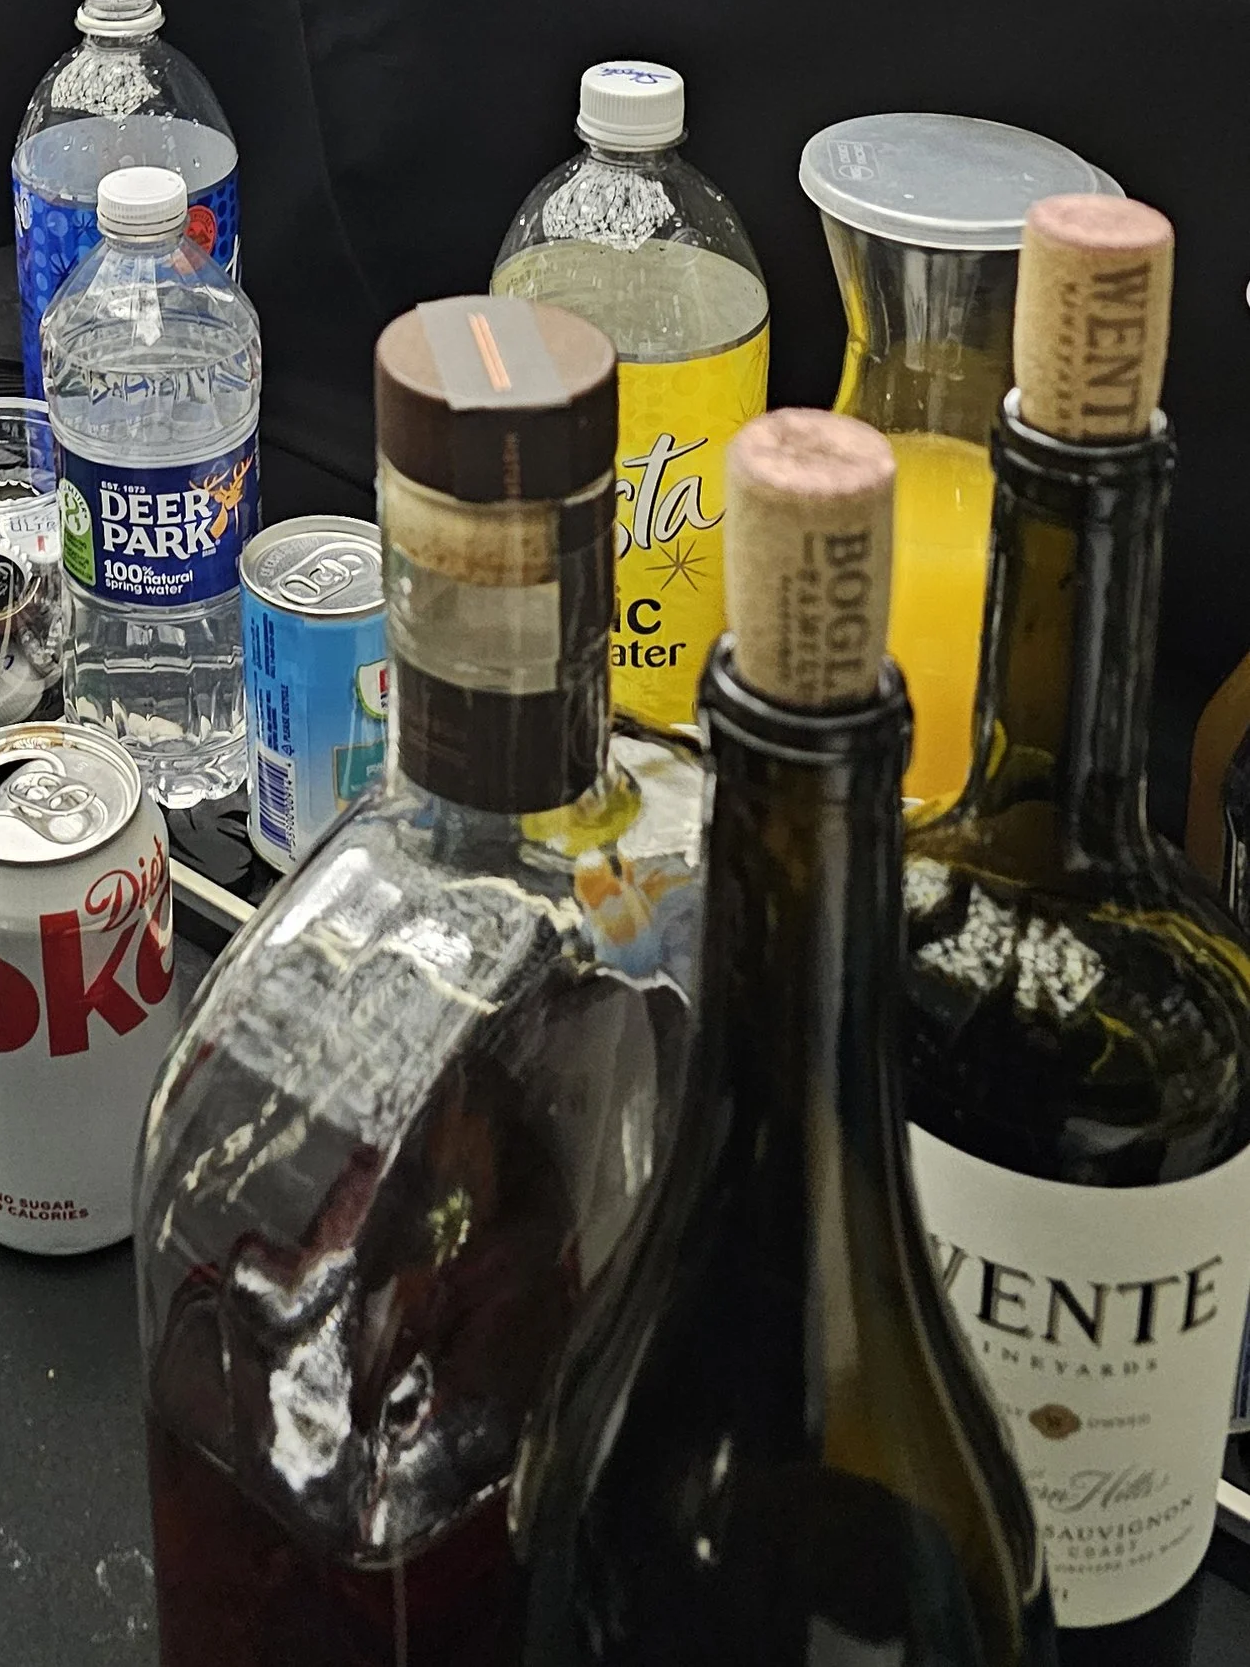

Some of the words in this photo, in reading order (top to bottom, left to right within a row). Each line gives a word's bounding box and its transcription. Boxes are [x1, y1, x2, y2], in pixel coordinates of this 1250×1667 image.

[101, 481, 121, 491] EST.
[100, 488, 213, 525] DEER
[102, 518, 216, 560] PARK
[104, 559, 155, 585] 100%
[143, 570, 193, 585] natural
[105, 578, 143, 595] spring
[145, 583, 184, 595] water
[85, 835, 169, 933] Diet
[7, 1206, 90, 1223] CALORIES
[18, 1196, 76, 1212] SUGAR
